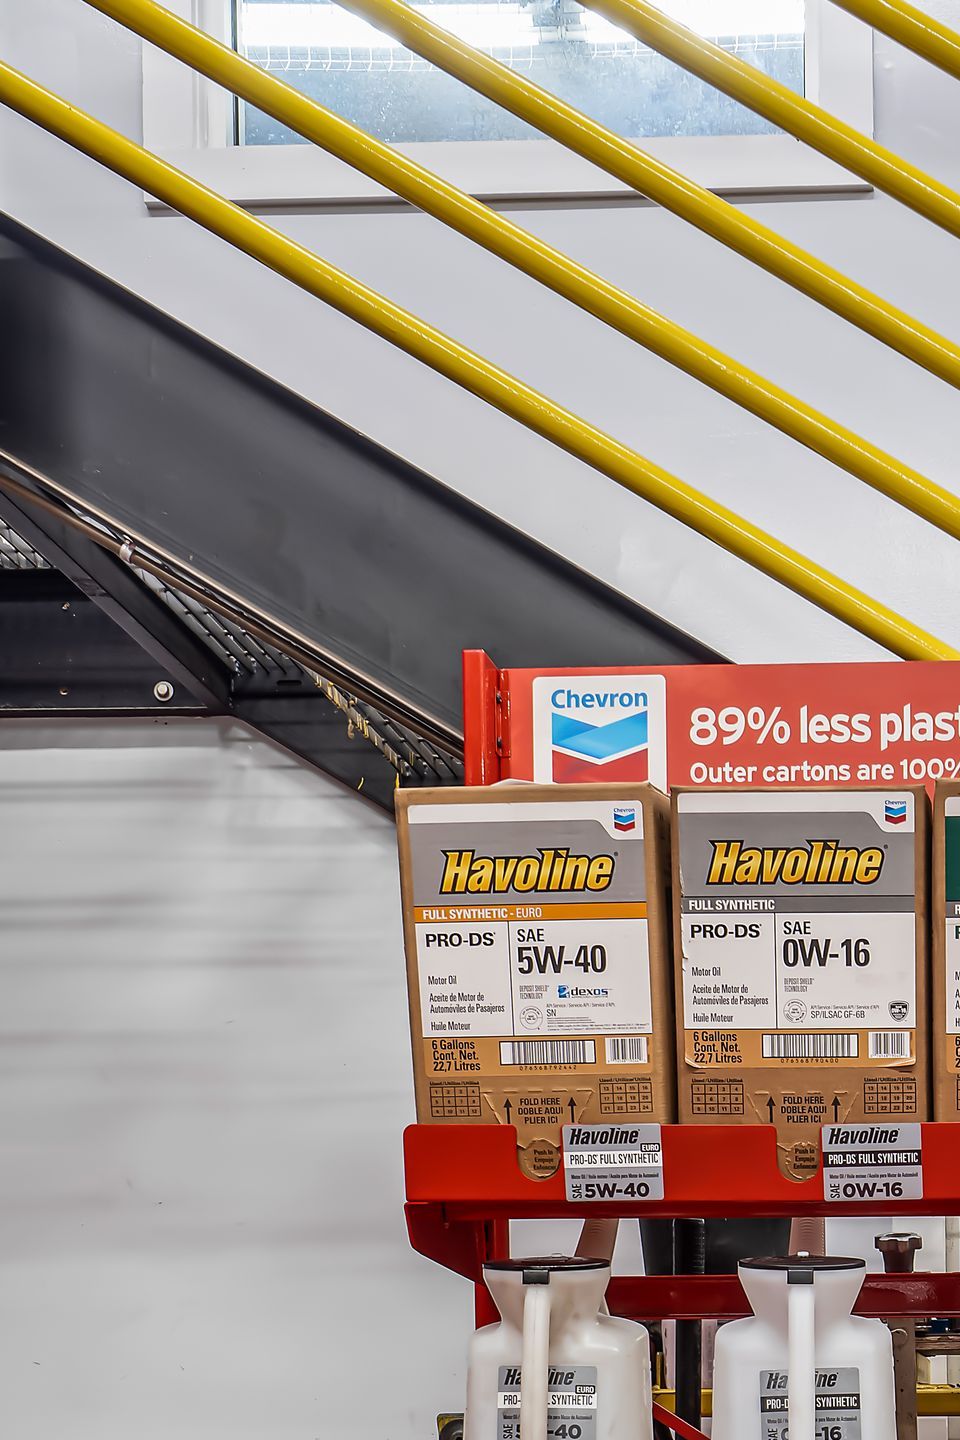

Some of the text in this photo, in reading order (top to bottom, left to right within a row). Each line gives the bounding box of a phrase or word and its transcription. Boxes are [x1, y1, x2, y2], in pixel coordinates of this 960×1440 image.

[551, 689, 648, 709] Chevron
[689, 706, 791, 746] 89%
[799, 704, 871, 744] less
[690, 761, 754, 784] Outer
[762, 761, 853, 783] cartons
[857, 764, 894, 781] are
[705, 839, 885, 886] Havoline
[439, 848, 616, 895] Havoline
[688, 899, 775, 910] FULL SYNTHETIC
[422, 909, 448, 920] FULL
[449, 908, 508, 920] SYNTHETIC
[515, 907, 542, 918] EURO
[516, 928, 545, 943] SAE
[690, 923, 761, 939] PRO-DS
[783, 921, 811, 935] SAE
[425, 932, 495, 948] PRO-DS
[517, 944, 607, 975] 5W-40
[782, 938, 871, 967] 0W-16
[570, 986, 609, 997] dexos
[569, 1127, 639, 1146] Havoline
[828, 1127, 899, 1145] Havoline
[570, 1153, 659, 1165] PRO-DS FULL SYNTHETIC
[828, 1152, 919, 1165] PRO-DS FULL SYNTHETIC
[572, 1182, 649, 1199] SAE 5W-40
[830, 1182, 903, 1198] SAE 0W-16
[551, 1394, 593, 1405] SYNTHETIC
[816, 1396, 858, 1408] SYNTHETIC
[503, 1424, 513, 1439] SAE
